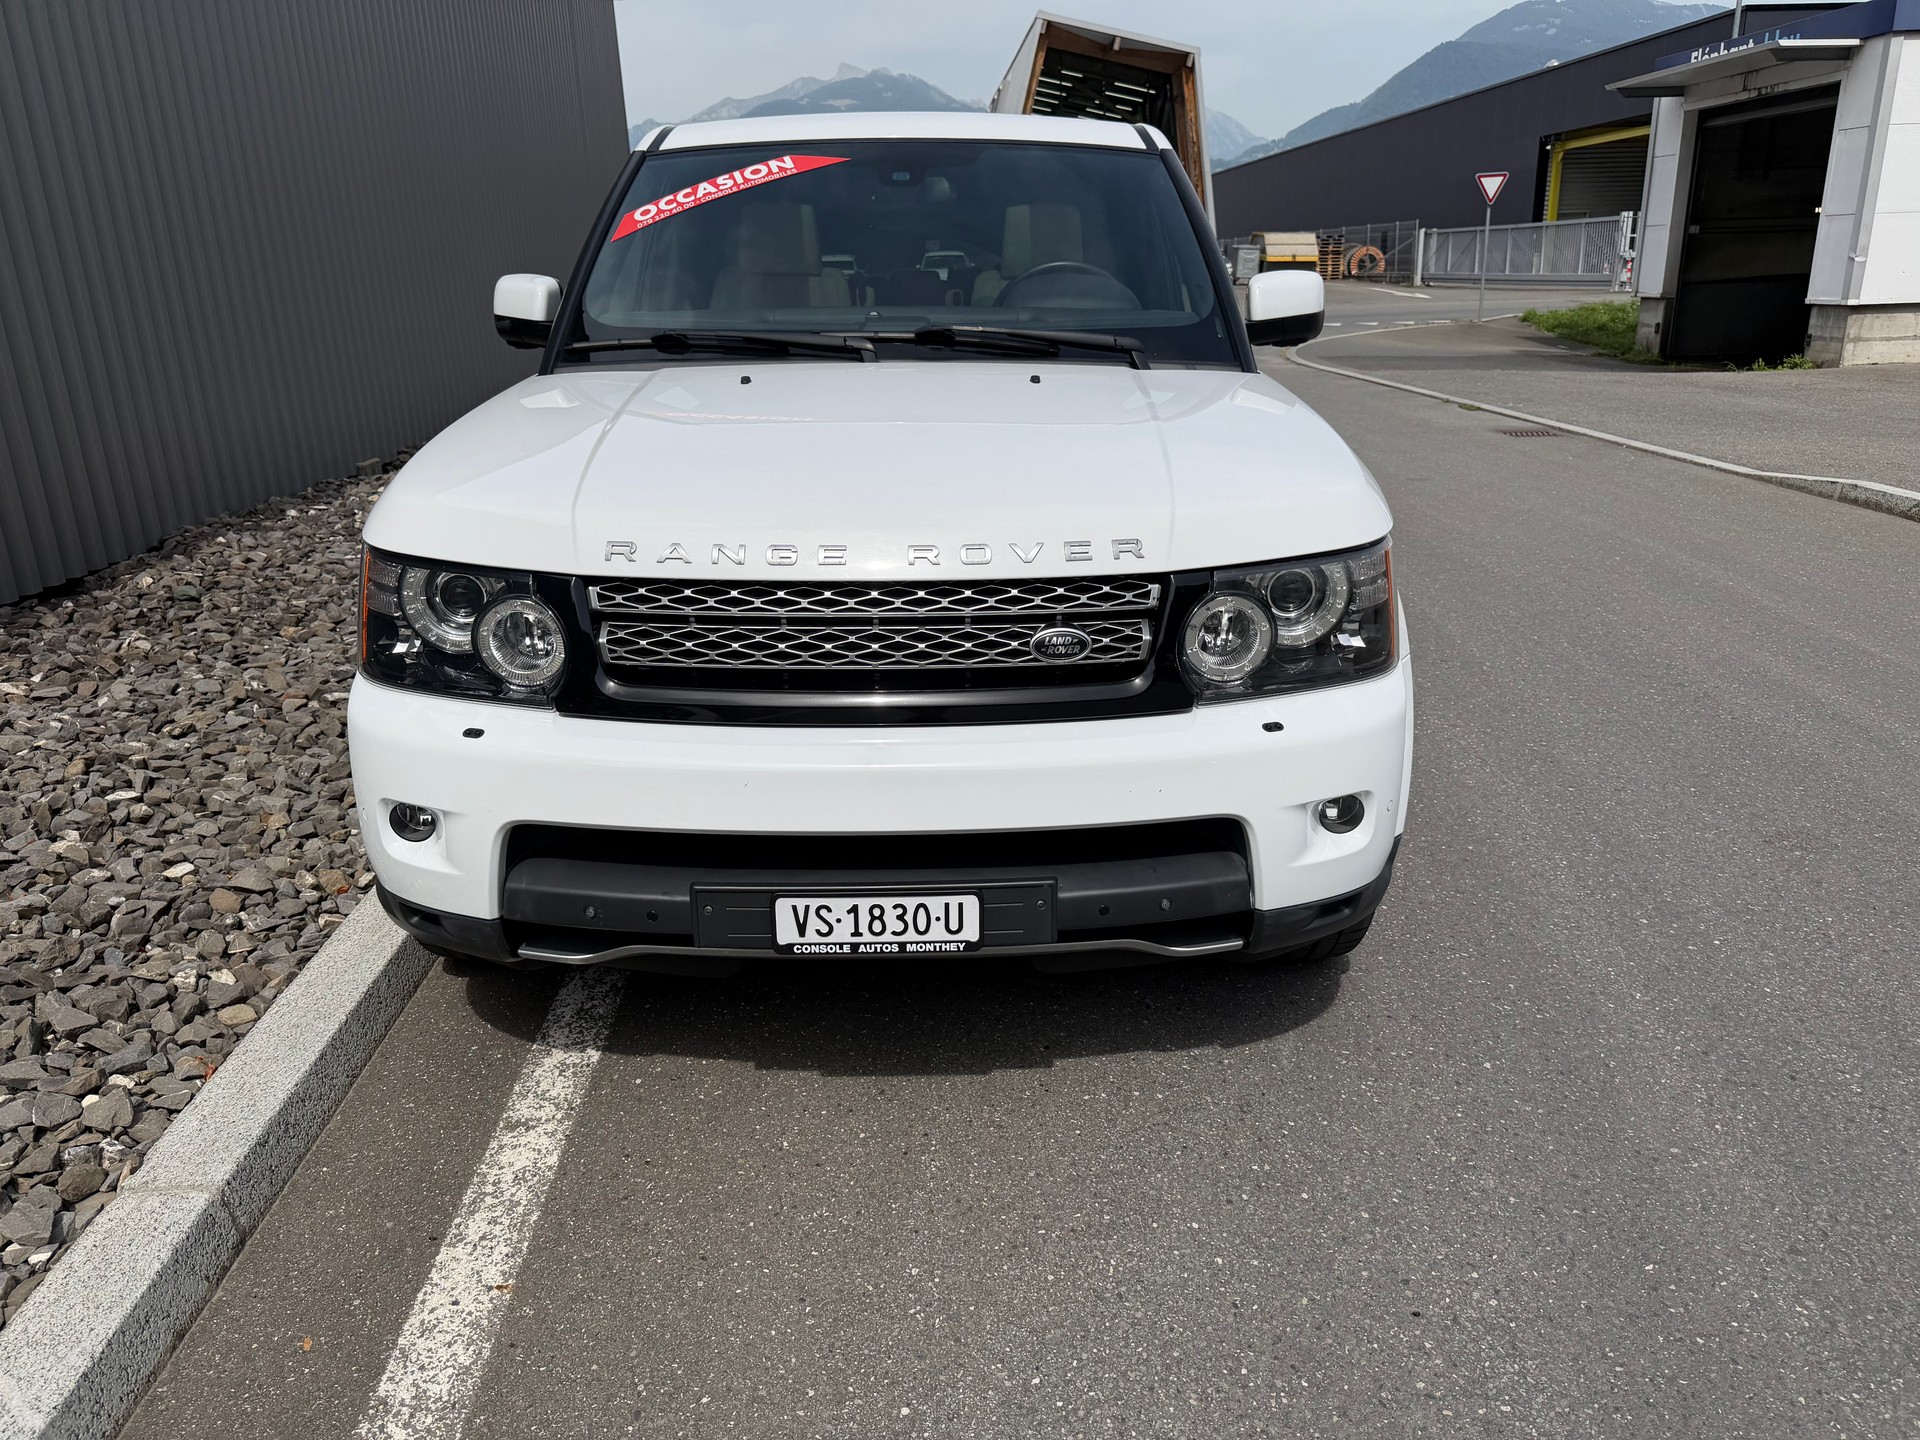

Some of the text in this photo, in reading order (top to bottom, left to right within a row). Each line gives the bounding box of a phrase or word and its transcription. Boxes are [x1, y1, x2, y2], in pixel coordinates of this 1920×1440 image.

[634, 155, 795, 221] OCCASION
[637, 218, 653, 229] 079
[672, 206, 682, 215] 40
[684, 201, 695, 210] 00
[701, 186, 737, 203] CONSOLE
[739, 168, 797, 190] AUTOMOBILES
[604, 538, 1145, 566] RANGE ROVER
[1044, 636, 1072, 646] LAND
[1047, 645, 1081, 654] ROVER
[793, 942, 966, 954] CONSOLE AUTOS MONTHEY
